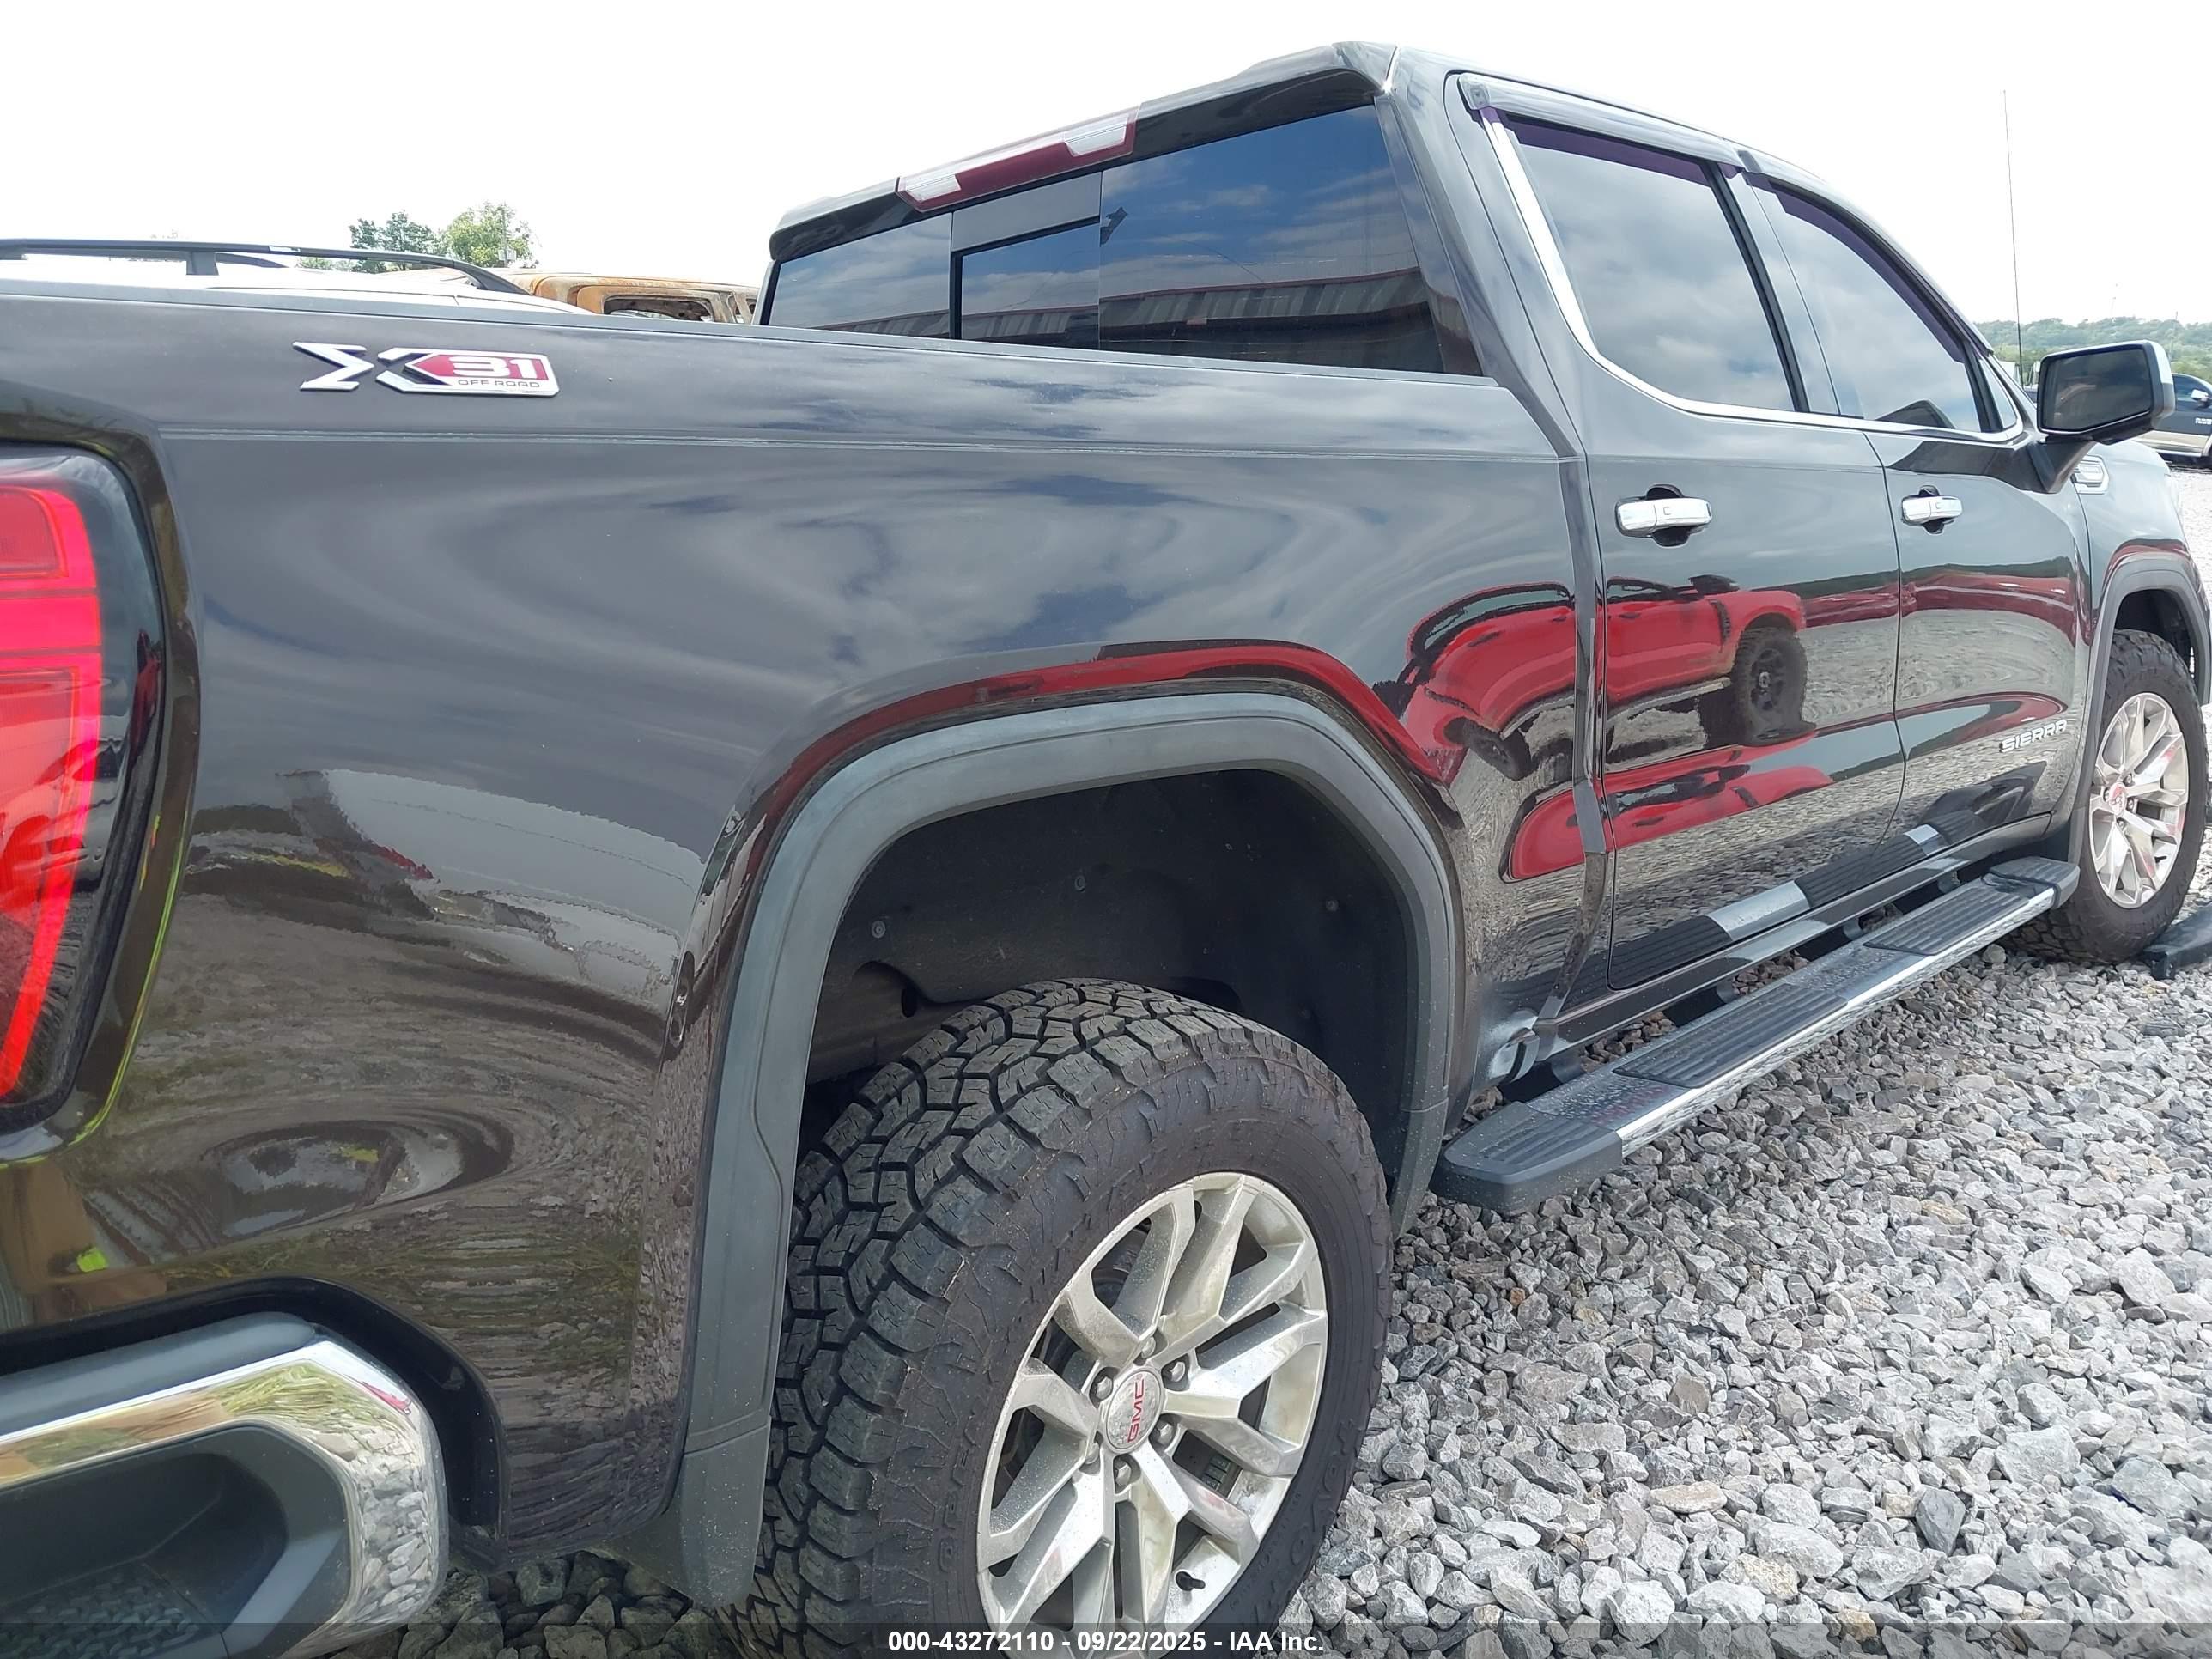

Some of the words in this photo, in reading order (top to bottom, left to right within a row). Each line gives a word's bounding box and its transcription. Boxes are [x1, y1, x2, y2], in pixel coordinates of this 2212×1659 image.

[458, 379, 491, 387] OFF
[495, 380, 541, 388] ROAD
[2000, 720, 2067, 753] SIERRA
[1127, 1379, 1145, 1443] GMC
